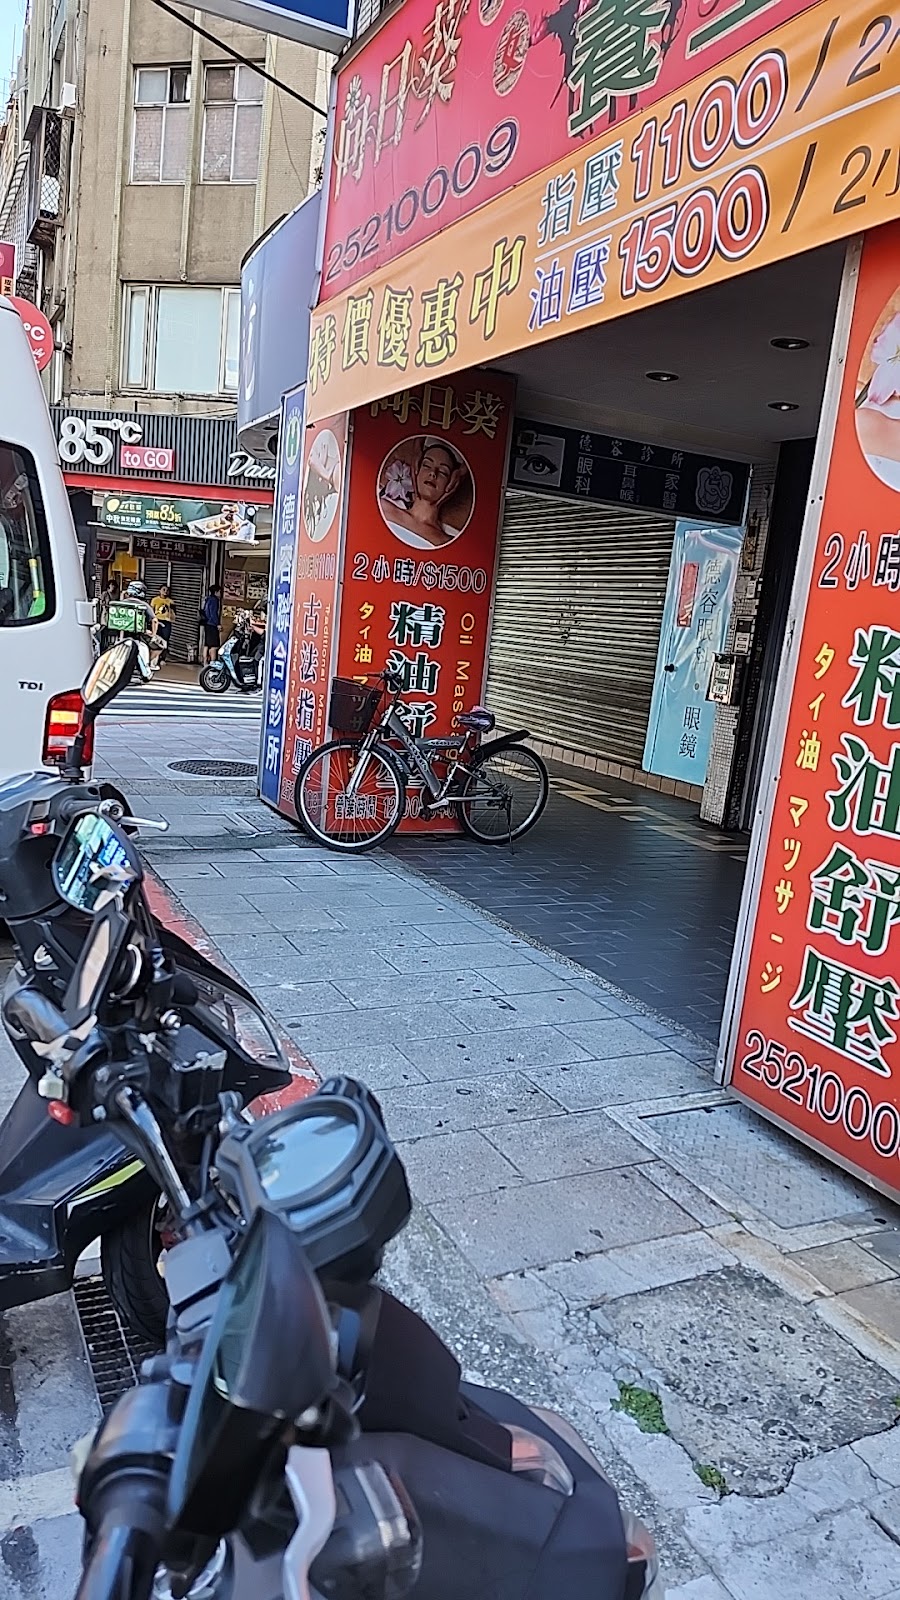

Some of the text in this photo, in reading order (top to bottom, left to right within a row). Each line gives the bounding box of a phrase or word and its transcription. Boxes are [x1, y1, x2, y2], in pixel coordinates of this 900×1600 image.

[536, 141, 624, 248] 指壓
[631, 48, 789, 202] 1100
[322, 116, 521, 286] 25210009
[526, 238, 611, 333] 油壓
[619, 165, 770, 299] 1500
[307, 236, 526, 397] 特價優惠中
[123, 452, 170, 470] to GO
[574, 456, 594, 495] 眼科
[578, 434, 685, 469] 德容診所
[662, 473, 681, 510] 家醫
[264, 492, 297, 776] 德容聯合診所
[459, 612, 476, 646] Oil
[692, 558, 722, 671] 德容眼科
[18, 681, 44, 691] TDI
[678, 706, 702, 760] 眼鏡
